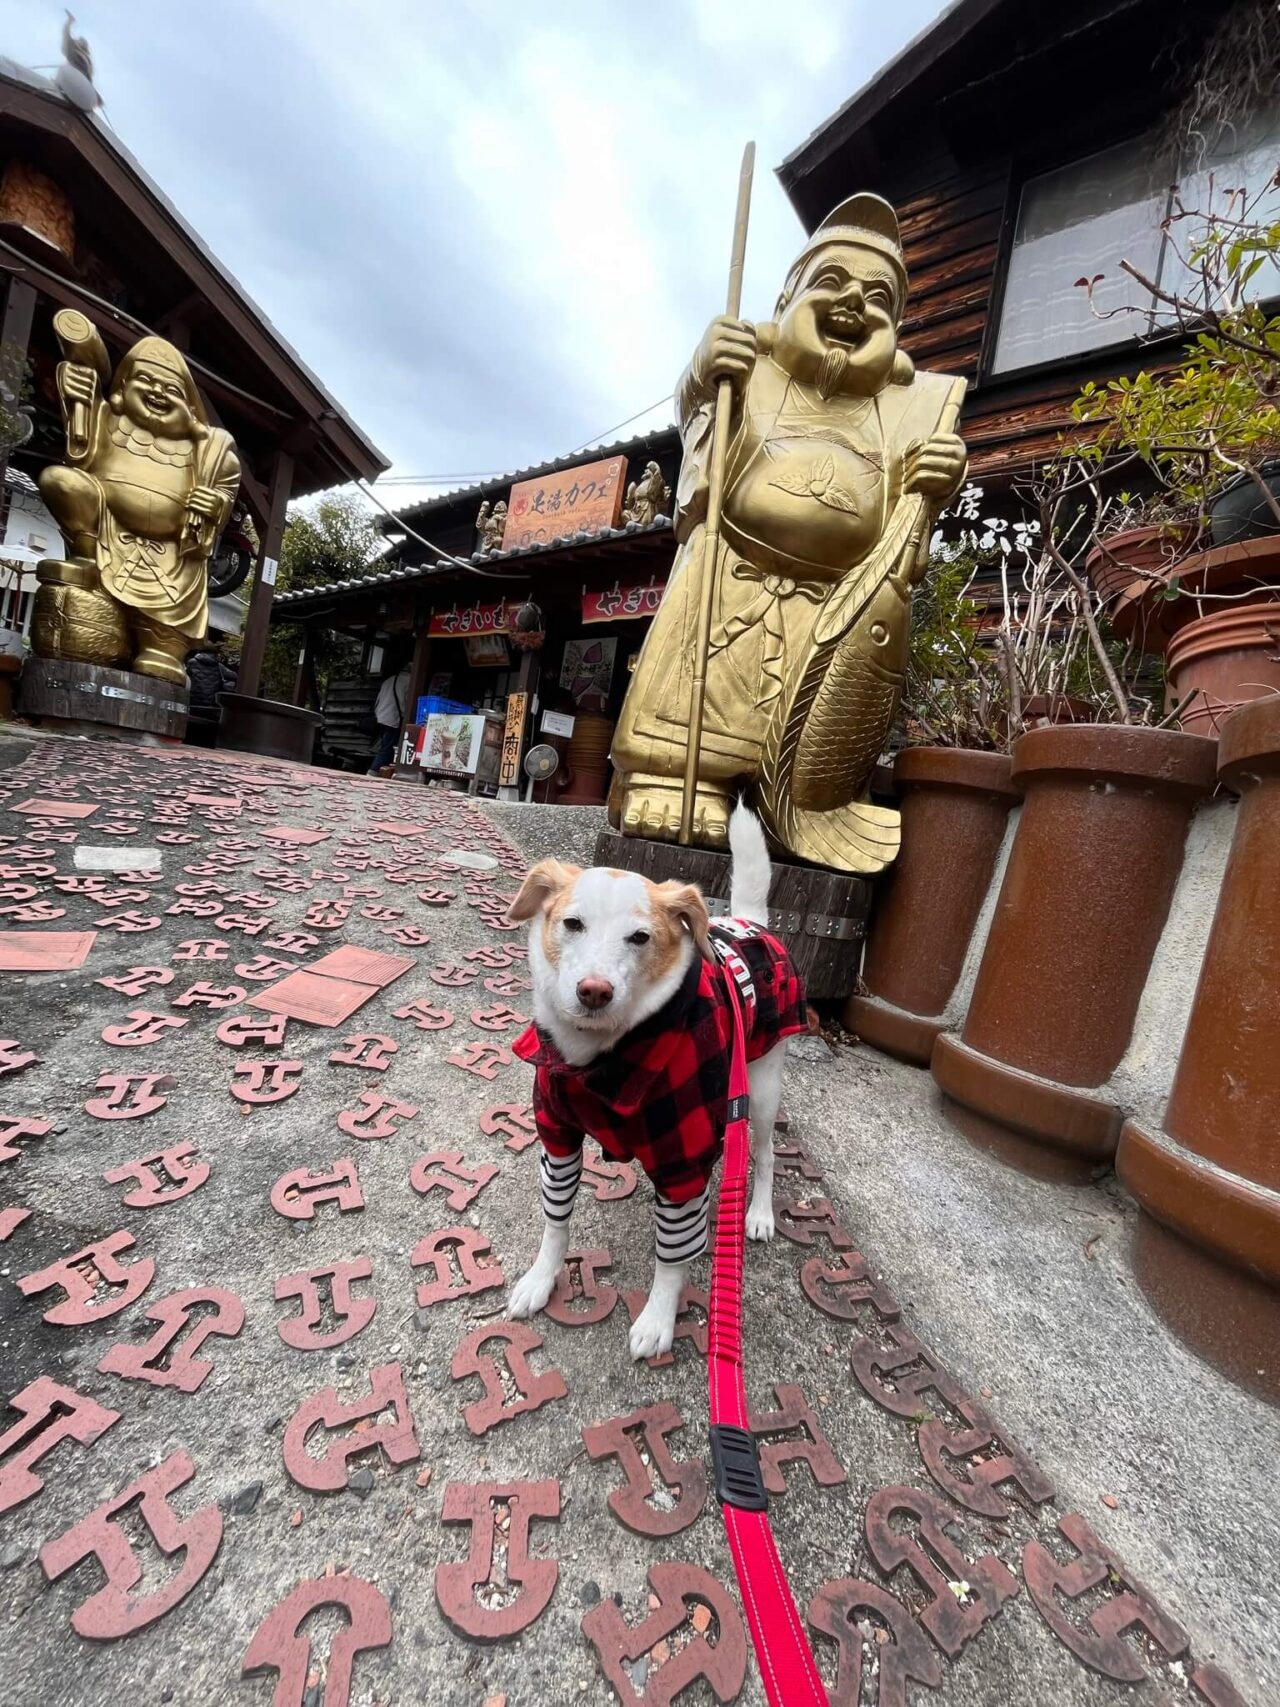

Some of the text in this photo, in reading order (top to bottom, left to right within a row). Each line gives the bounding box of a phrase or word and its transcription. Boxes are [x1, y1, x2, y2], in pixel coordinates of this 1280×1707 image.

[530, 482, 608, 515] 足湯カフェ
